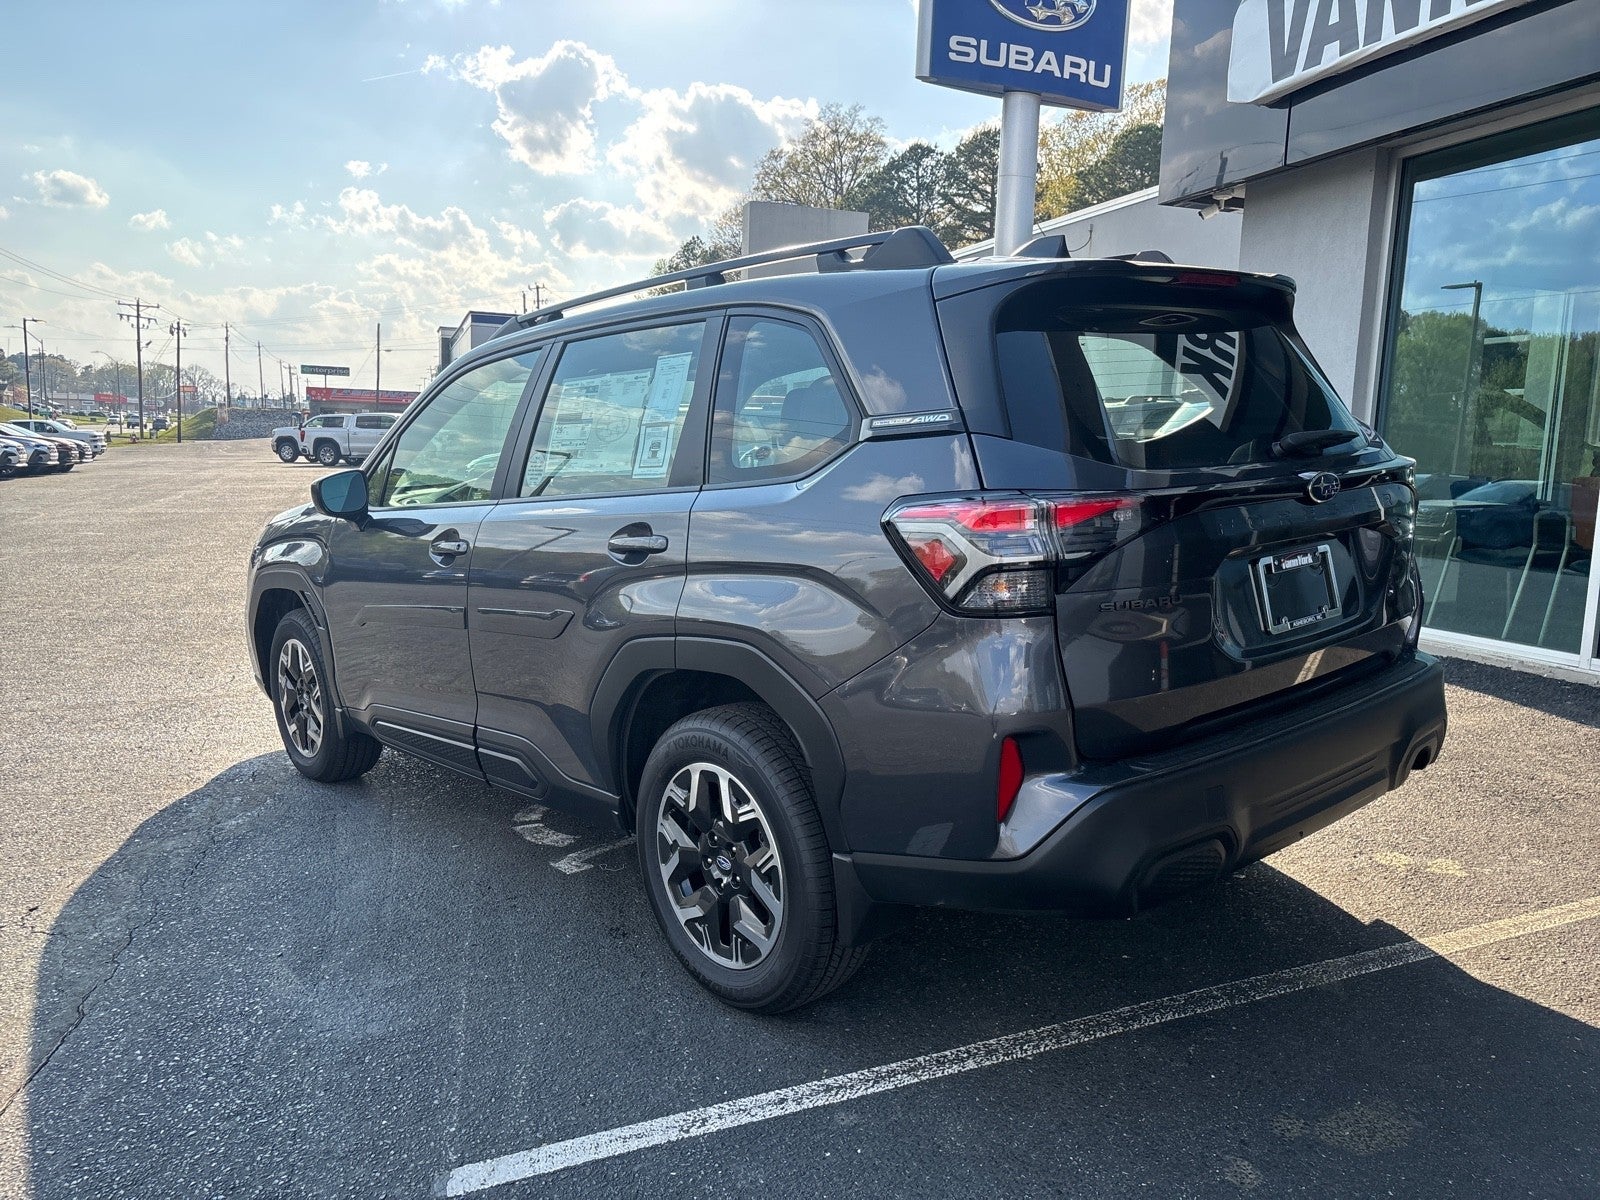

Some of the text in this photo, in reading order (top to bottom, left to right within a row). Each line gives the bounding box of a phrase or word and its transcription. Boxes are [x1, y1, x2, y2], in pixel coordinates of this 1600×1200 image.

[948, 35, 1112, 89] SUBARU
[303, 366, 349, 375] enterprise
[912, 414, 950, 424] AWD
[1099, 595, 1183, 612] SUBARU
[673, 734, 729, 760] YOKOHAMA
